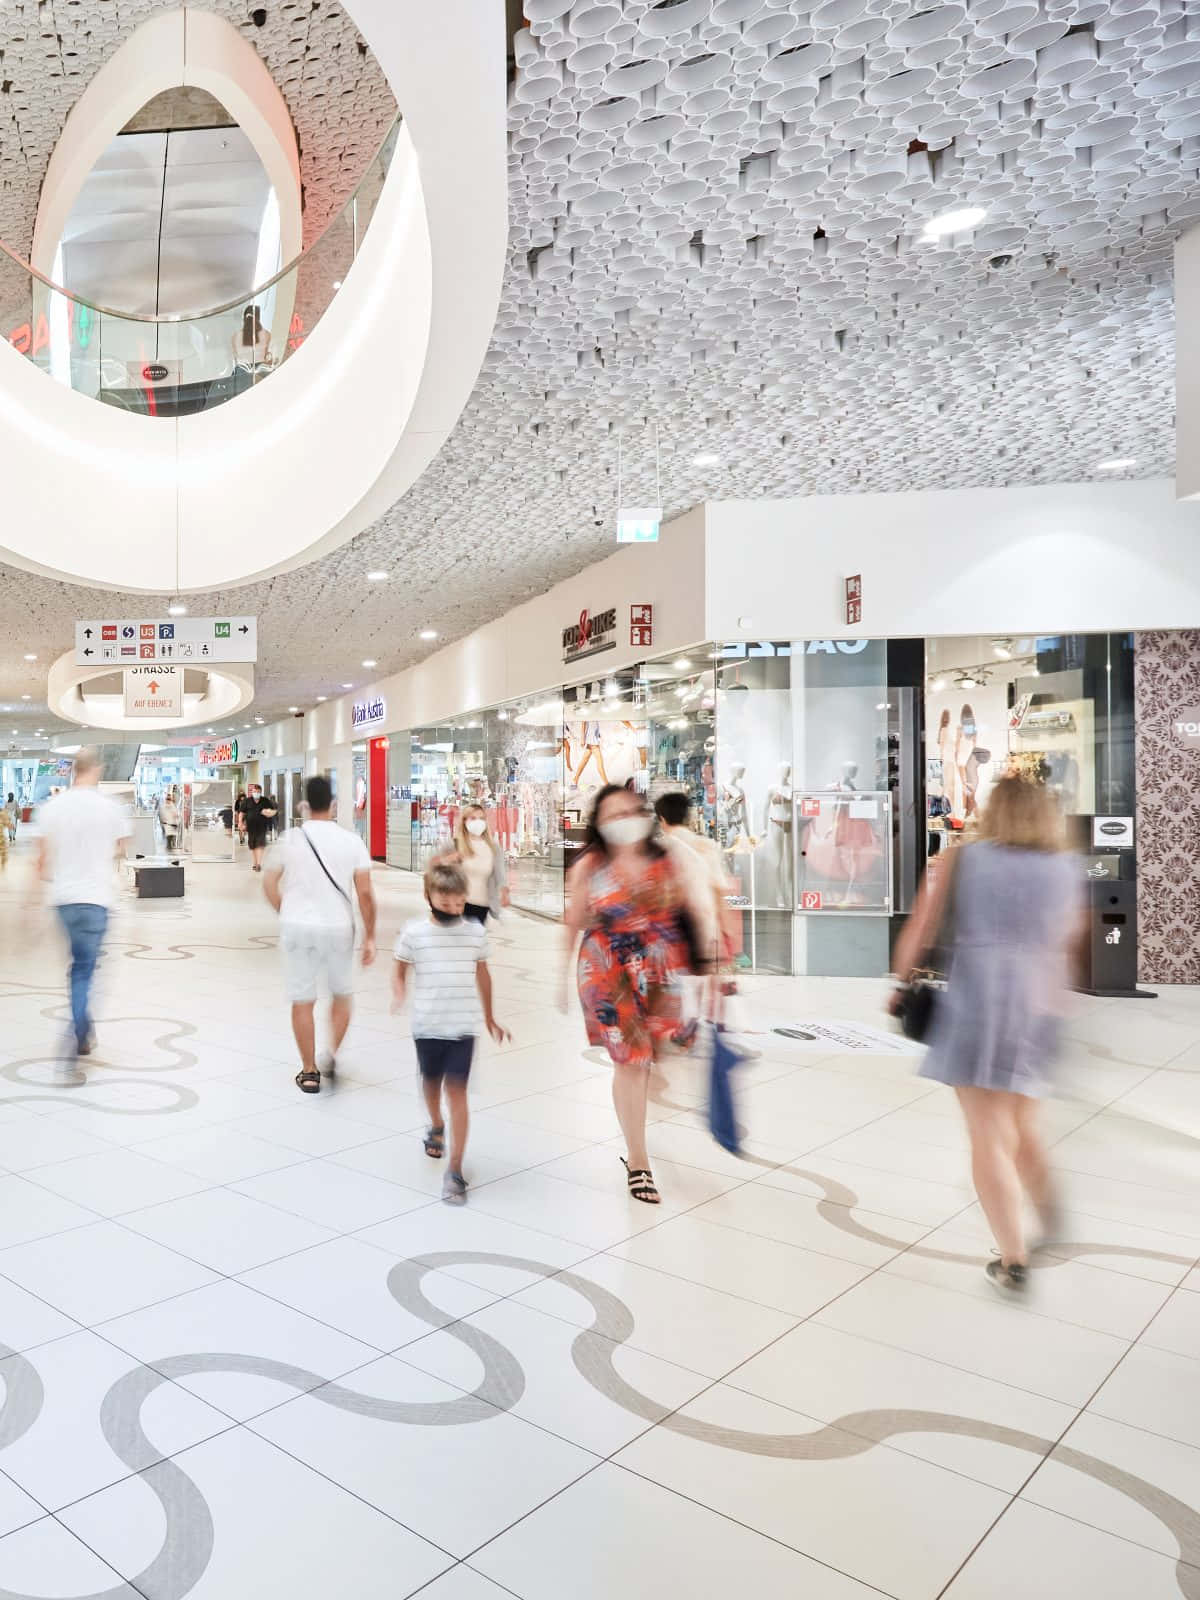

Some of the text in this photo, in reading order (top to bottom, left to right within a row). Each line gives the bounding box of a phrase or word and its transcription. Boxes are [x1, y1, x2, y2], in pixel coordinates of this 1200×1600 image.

[141, 628, 154, 636] U3
[216, 626, 229, 634] U4
[1174, 722, 1200, 734] TO
